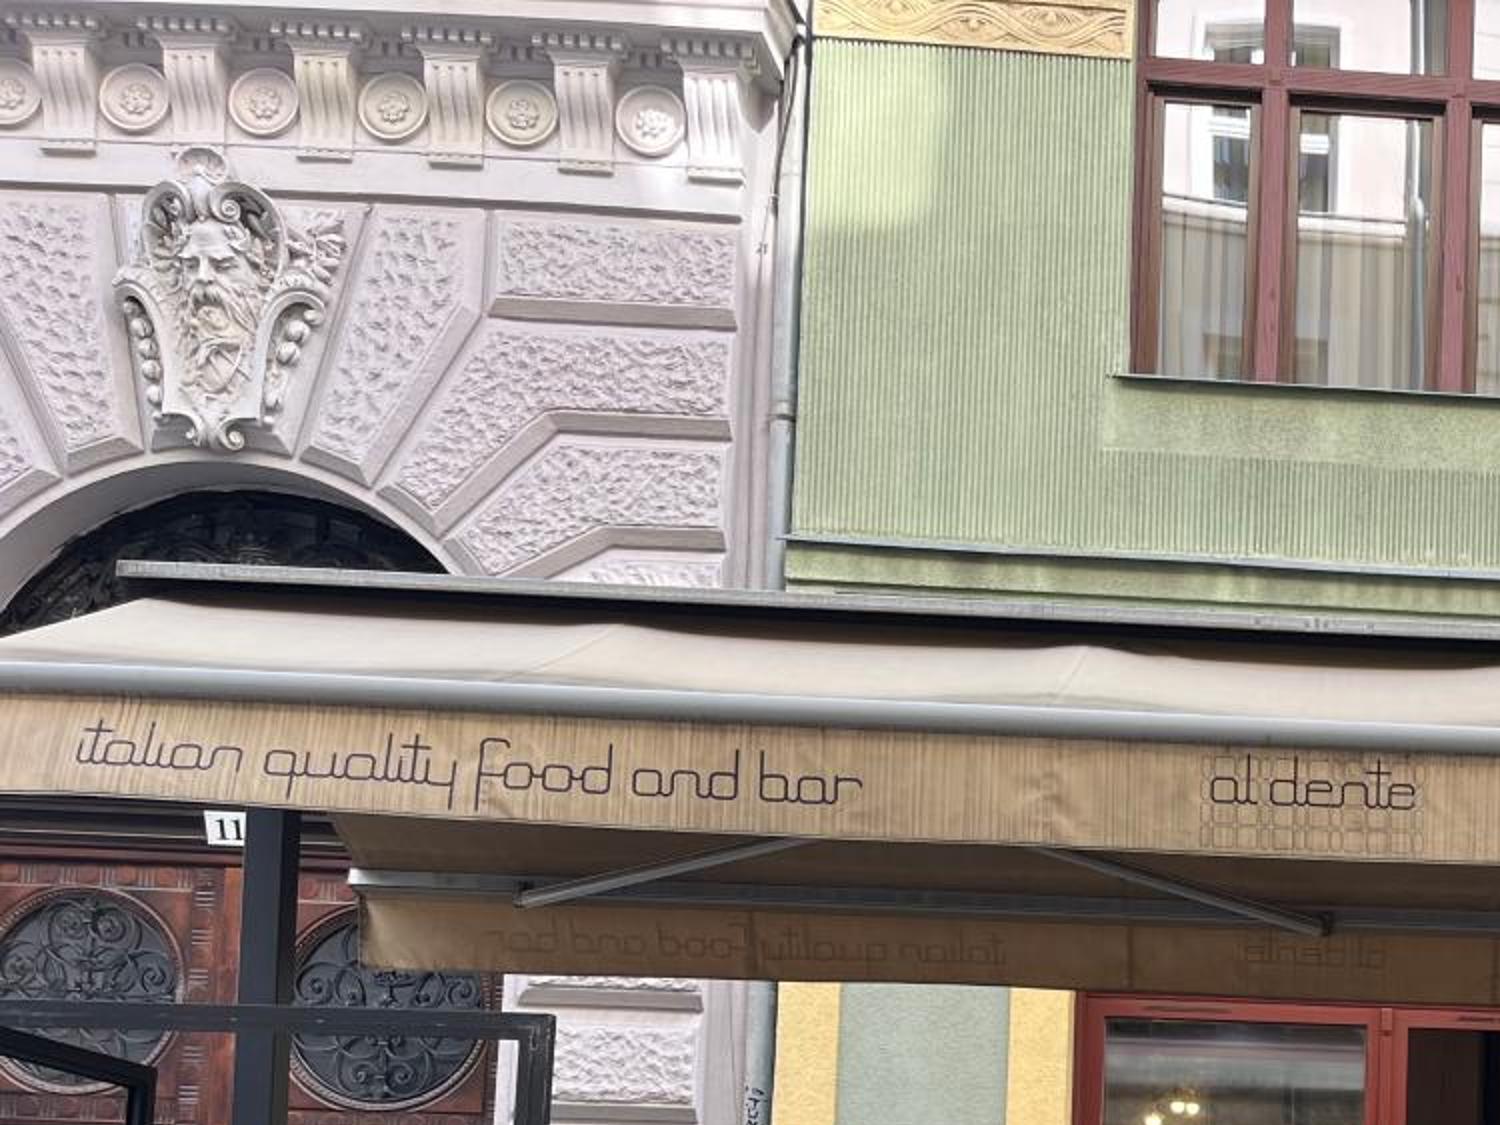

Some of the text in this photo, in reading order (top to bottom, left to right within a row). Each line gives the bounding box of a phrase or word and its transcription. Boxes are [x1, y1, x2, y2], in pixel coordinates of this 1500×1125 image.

[76, 719, 864, 812] italian quality food and bar
[1270, 755, 1415, 811] dente
[214, 818, 243, 841] 11
